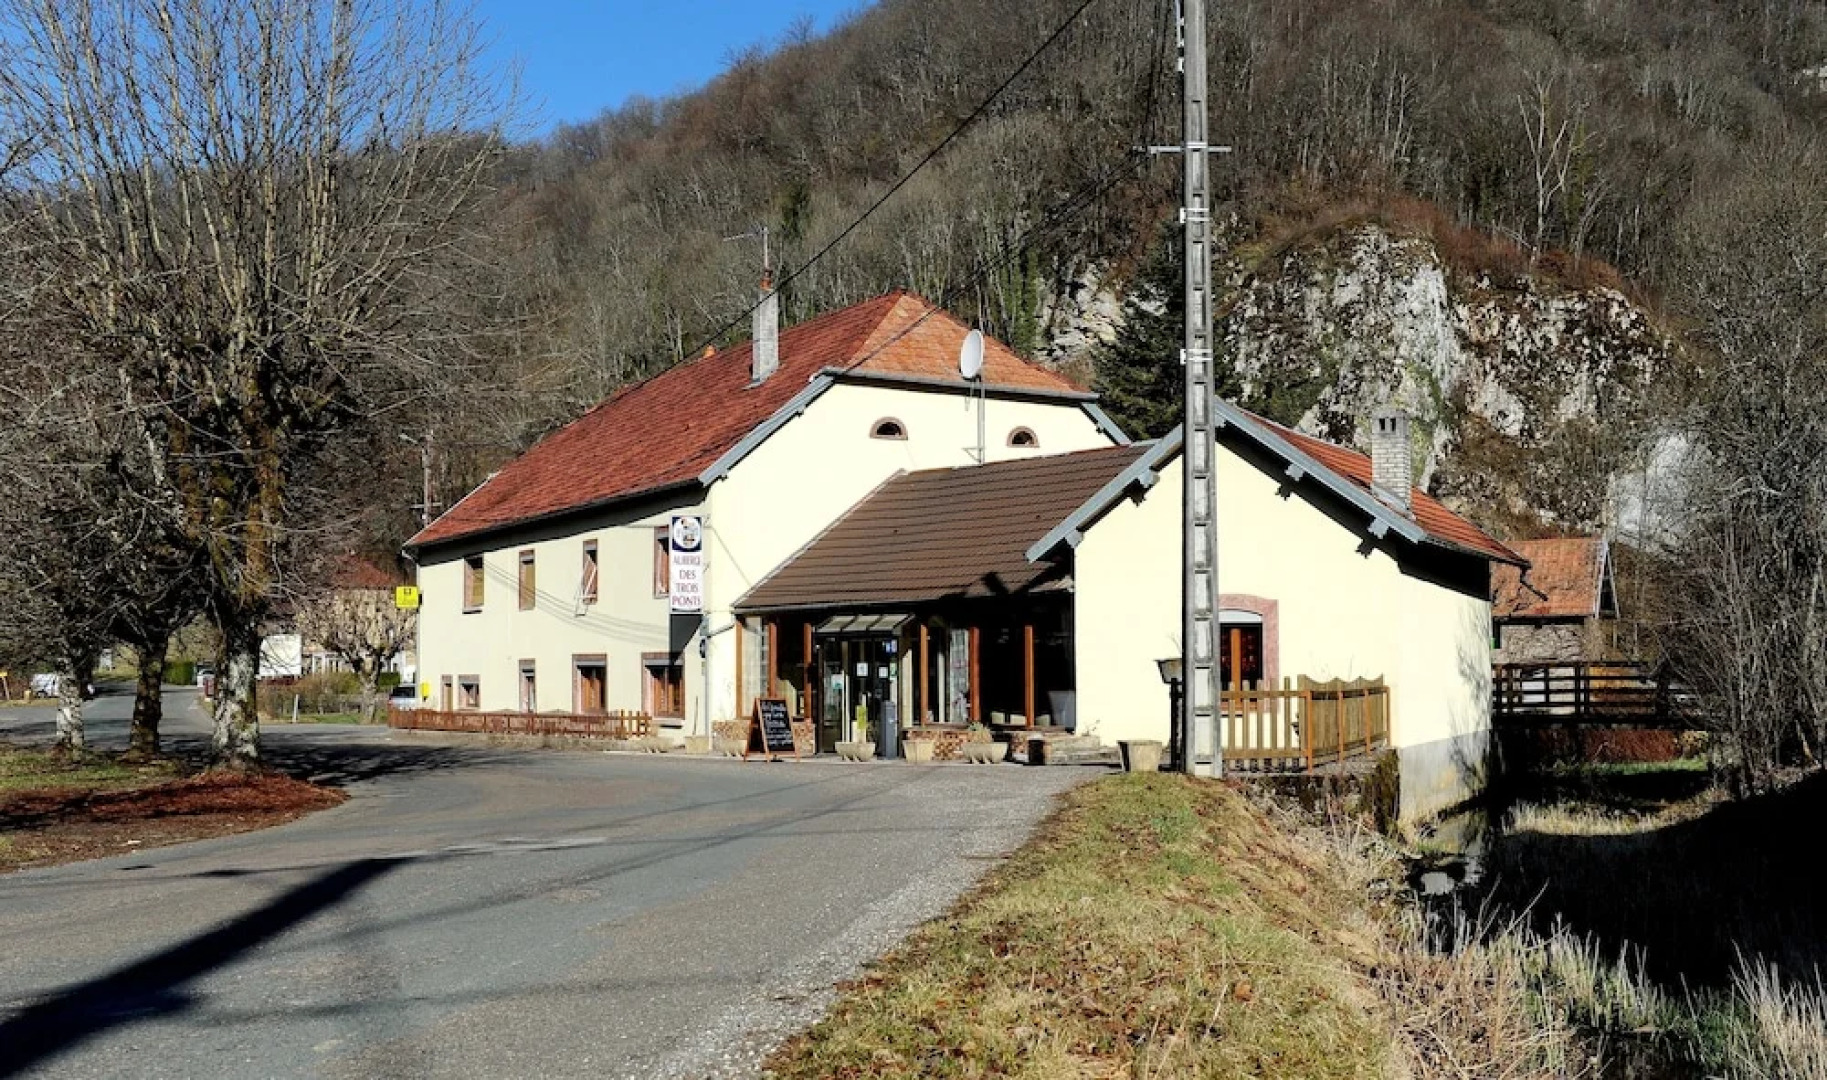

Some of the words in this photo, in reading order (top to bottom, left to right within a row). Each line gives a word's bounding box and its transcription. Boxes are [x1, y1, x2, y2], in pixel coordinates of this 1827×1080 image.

[679, 569, 696, 579] DES
[675, 583, 698, 592] TROIS
[672, 595, 700, 605] PONTS
